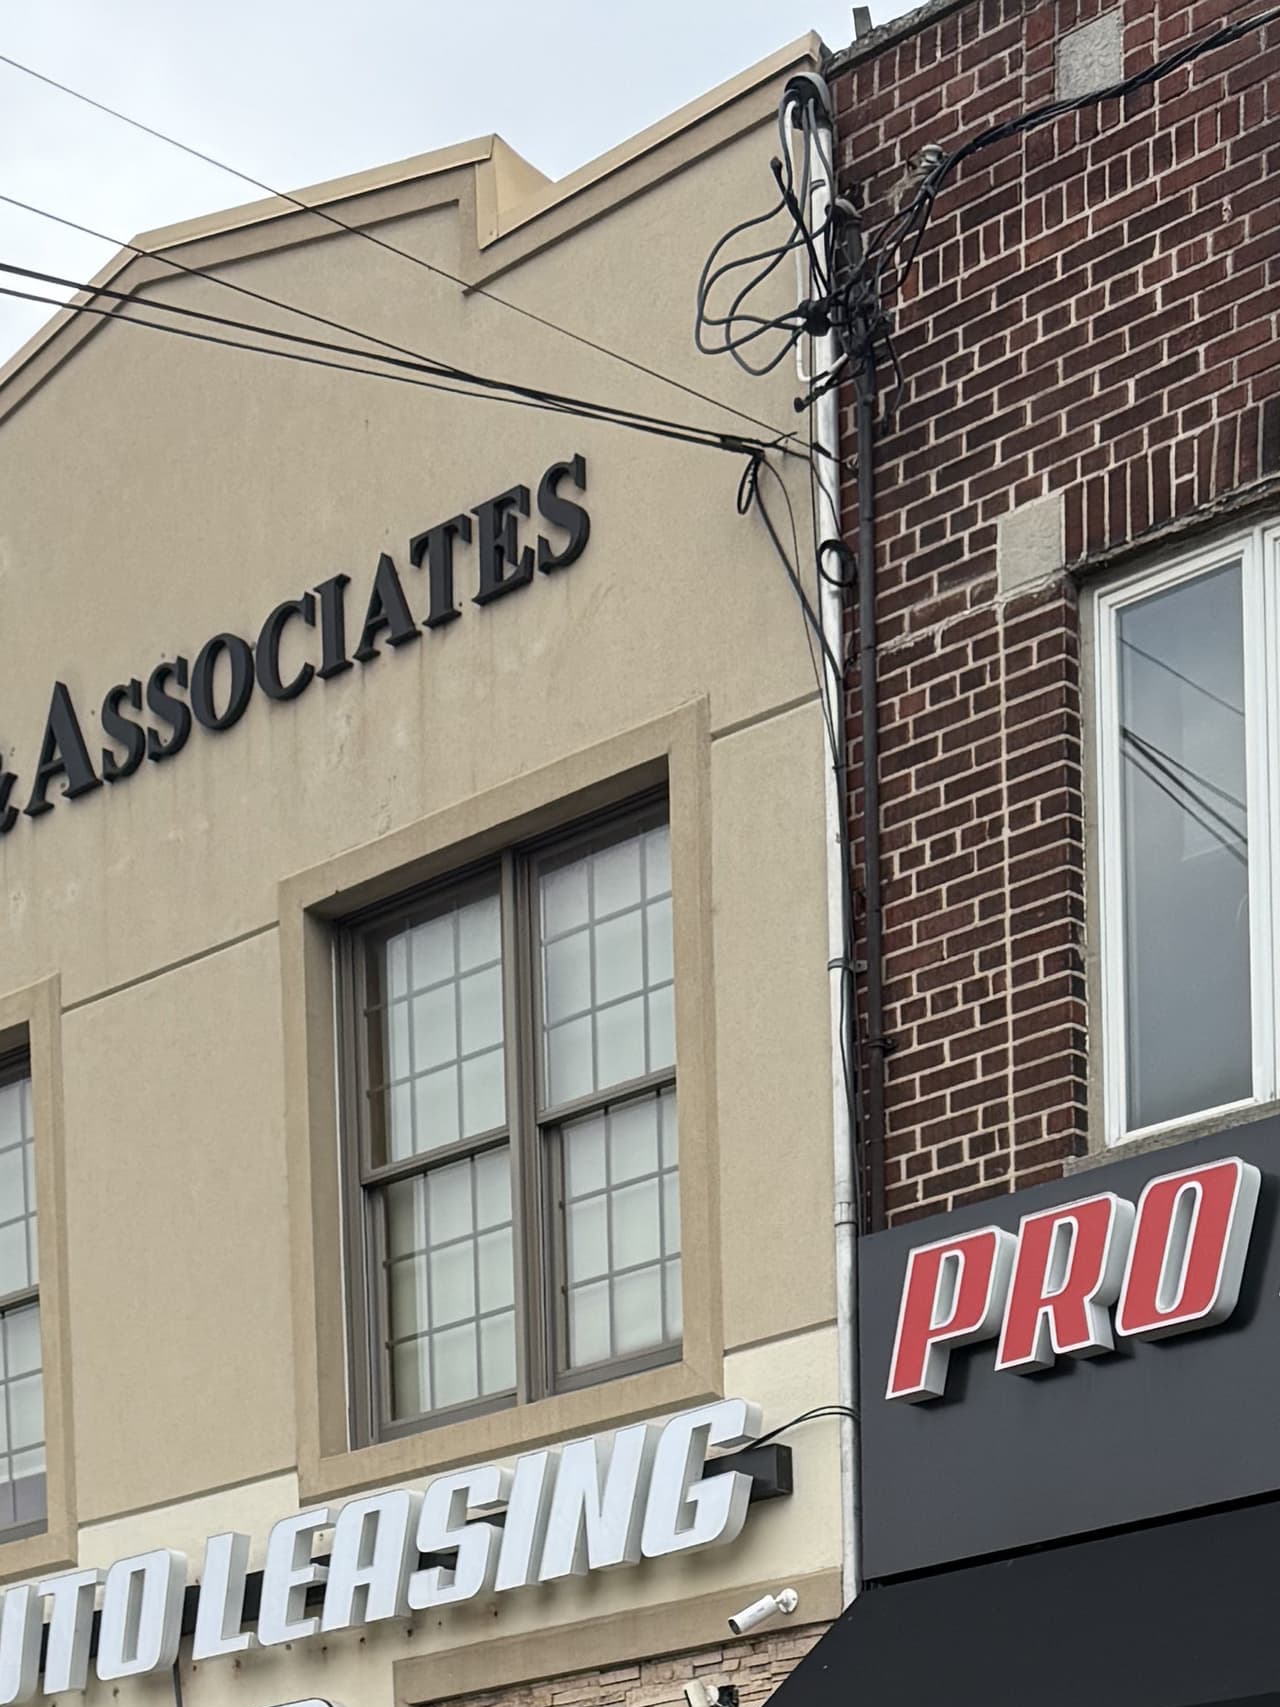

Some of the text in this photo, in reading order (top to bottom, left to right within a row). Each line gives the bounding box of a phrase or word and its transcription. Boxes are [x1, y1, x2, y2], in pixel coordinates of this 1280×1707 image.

[23, 452, 590, 816] ASSOCIATES
[885, 1155, 1262, 1405] PRO
[191, 1397, 763, 1660] LEASING
